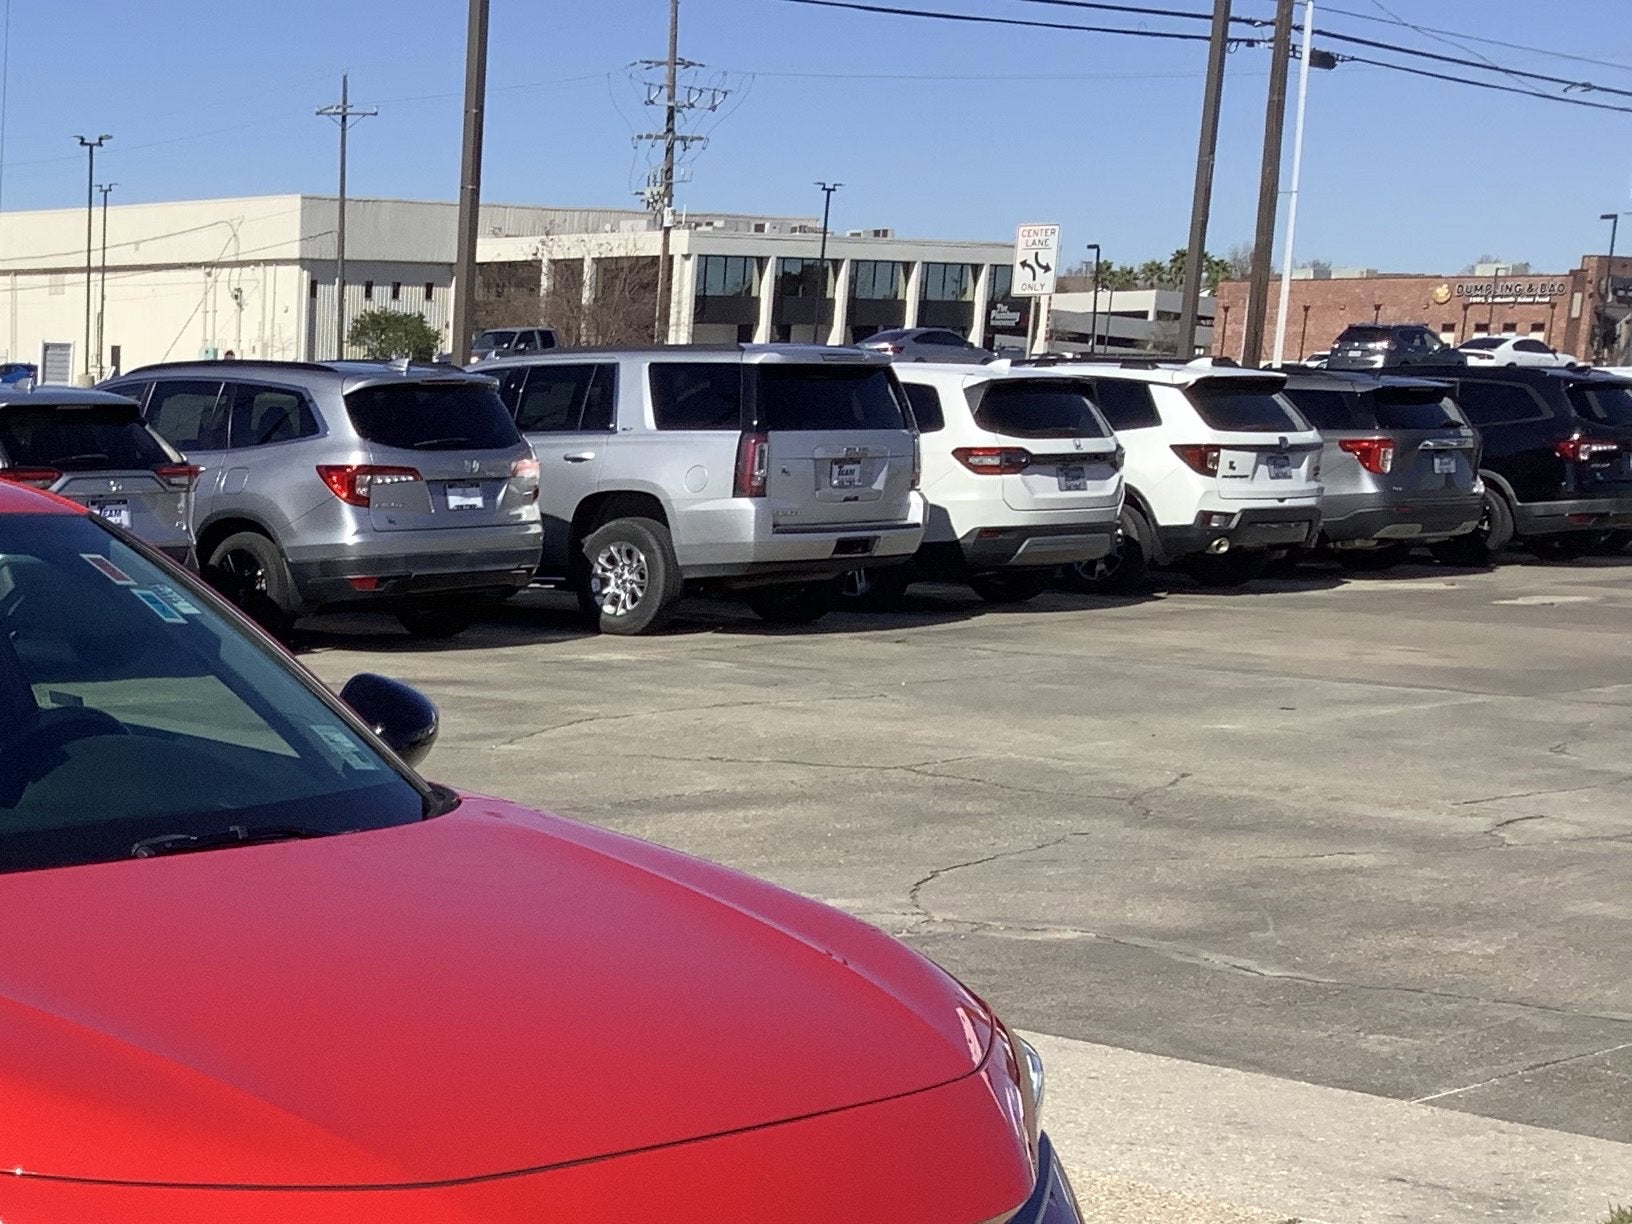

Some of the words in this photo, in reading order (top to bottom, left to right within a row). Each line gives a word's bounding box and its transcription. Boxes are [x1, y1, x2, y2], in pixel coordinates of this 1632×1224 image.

[1021, 228, 1056, 238] CENTER
[1025, 238, 1050, 248] LANE
[1020, 283, 1045, 292] ONLY
